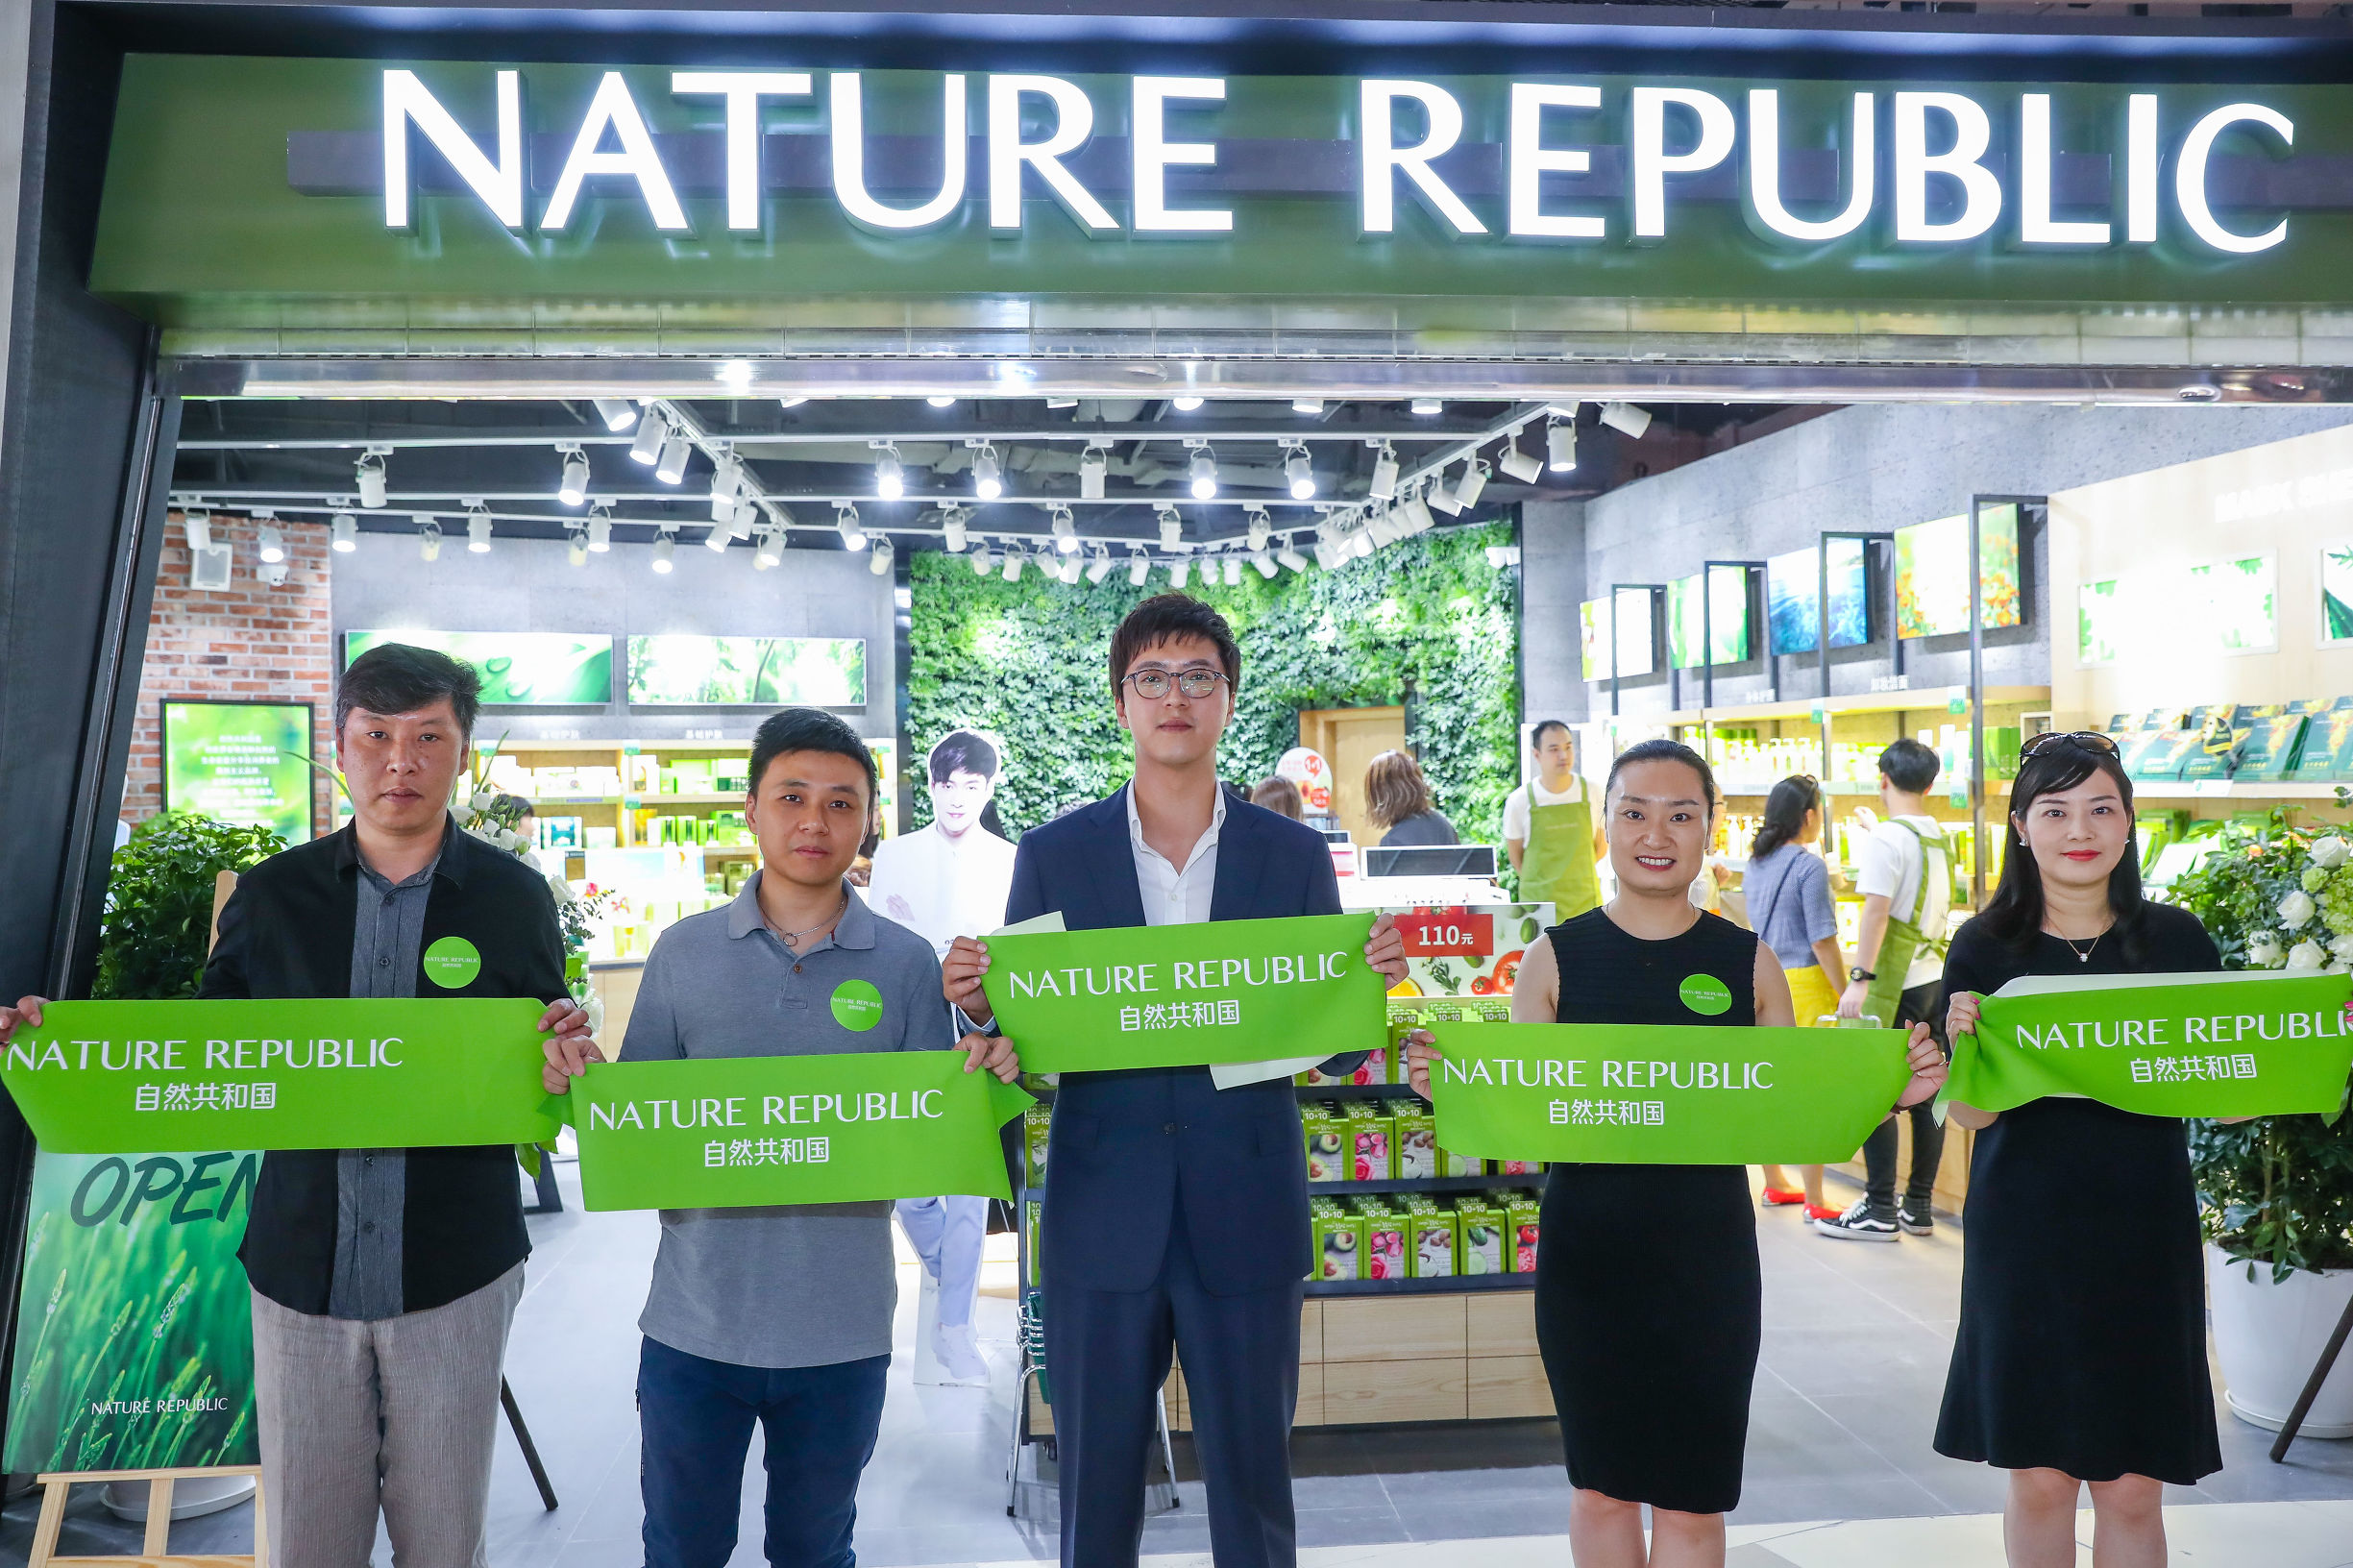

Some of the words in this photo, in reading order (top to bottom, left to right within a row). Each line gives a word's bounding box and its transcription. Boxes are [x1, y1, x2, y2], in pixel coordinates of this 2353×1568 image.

[382, 69, 1233, 232] NATURE
[1361, 79, 2294, 253] REPUBLIC
[1418, 925, 1475, 946] 110元
[1009, 964, 1157, 999] NATURE
[1173, 950, 1348, 990] REPUBLIC
[1119, 999, 1241, 1033] 自然共和国
[1393, 1015, 1417, 1024] 10+10
[1436, 1013, 1461, 1022] 10+10
[1484, 1012, 1508, 1021] 10+10
[2016, 1018, 2169, 1050] NATURE
[7, 1040, 187, 1071] NATURE
[205, 1037, 404, 1069] REPUBLIC
[2129, 1053, 2258, 1083] 自然共和国
[1443, 1058, 1588, 1088] NATURE
[1602, 1060, 1774, 1090] REPUBLIC
[135, 1082, 277, 1112] 自然共和国
[590, 1096, 747, 1131] NATURE
[763, 1089, 944, 1125] REPUBLIC
[1549, 1098, 1665, 1126] 自然共和国
[1305, 1112, 1328, 1120] 10+10
[1350, 1111, 1374, 1119] 10+10
[704, 1136, 830, 1167] 自然共和国
[1462, 1205, 1485, 1213] 10+10
[91, 1400, 152, 1415] NATURE
[156, 1397, 229, 1413] REPUBLIC
